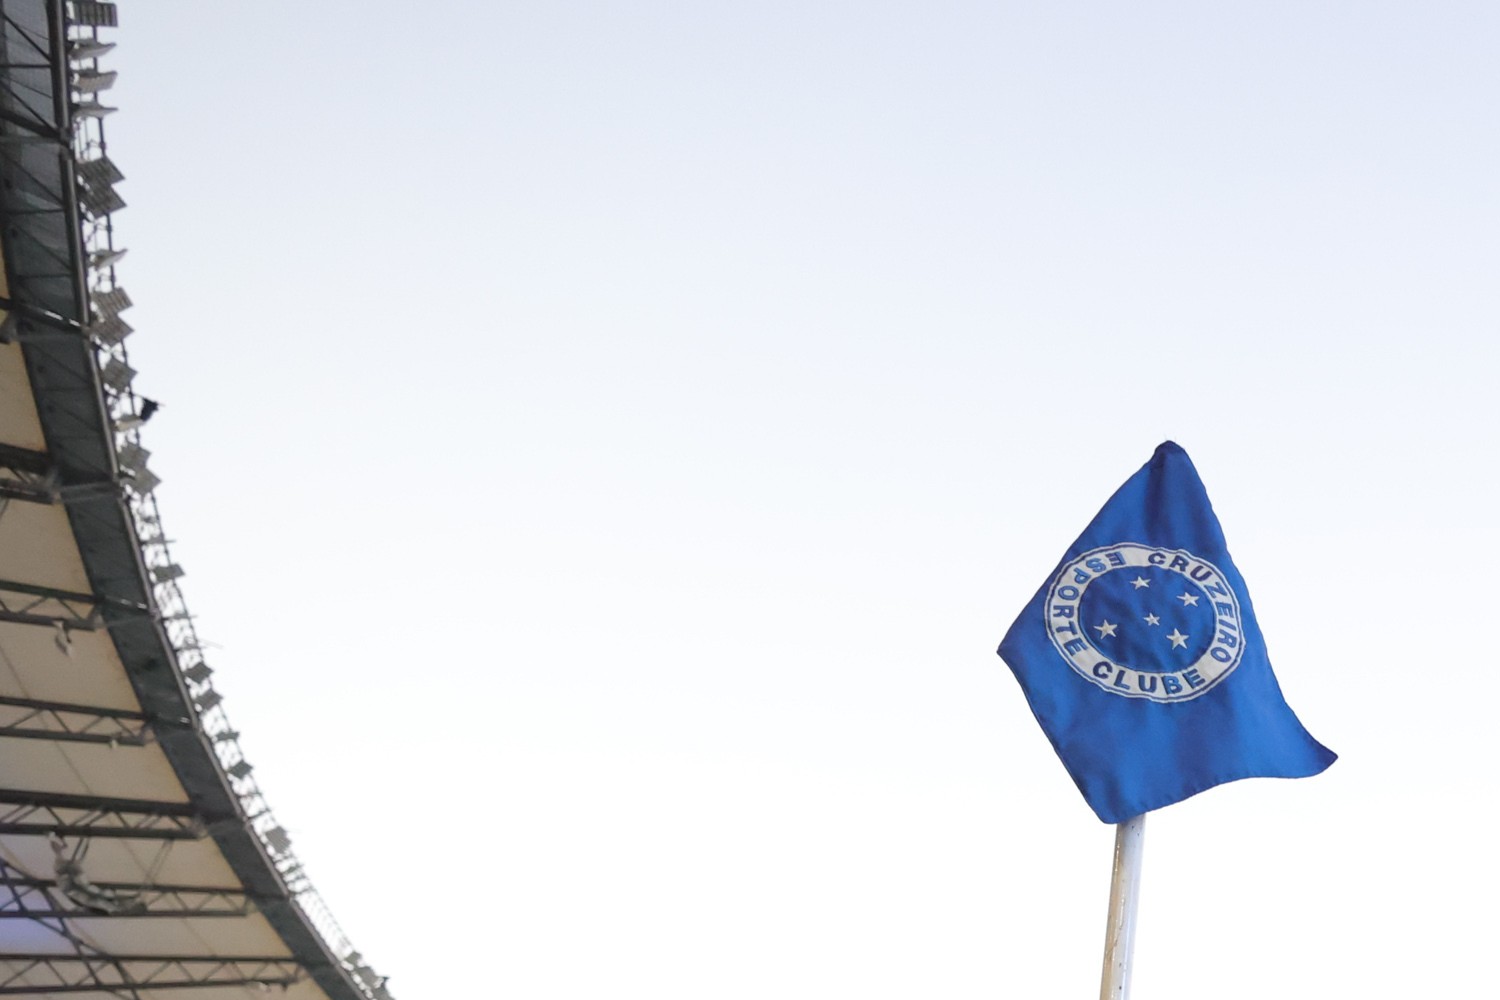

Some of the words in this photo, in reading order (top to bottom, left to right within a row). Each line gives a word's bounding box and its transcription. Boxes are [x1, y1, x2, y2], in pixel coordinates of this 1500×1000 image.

[1053, 551, 1126, 656] ESPORTE
[1148, 552, 1236, 664] CRUZEIRO
[1092, 660, 1206, 696] CLUBE
